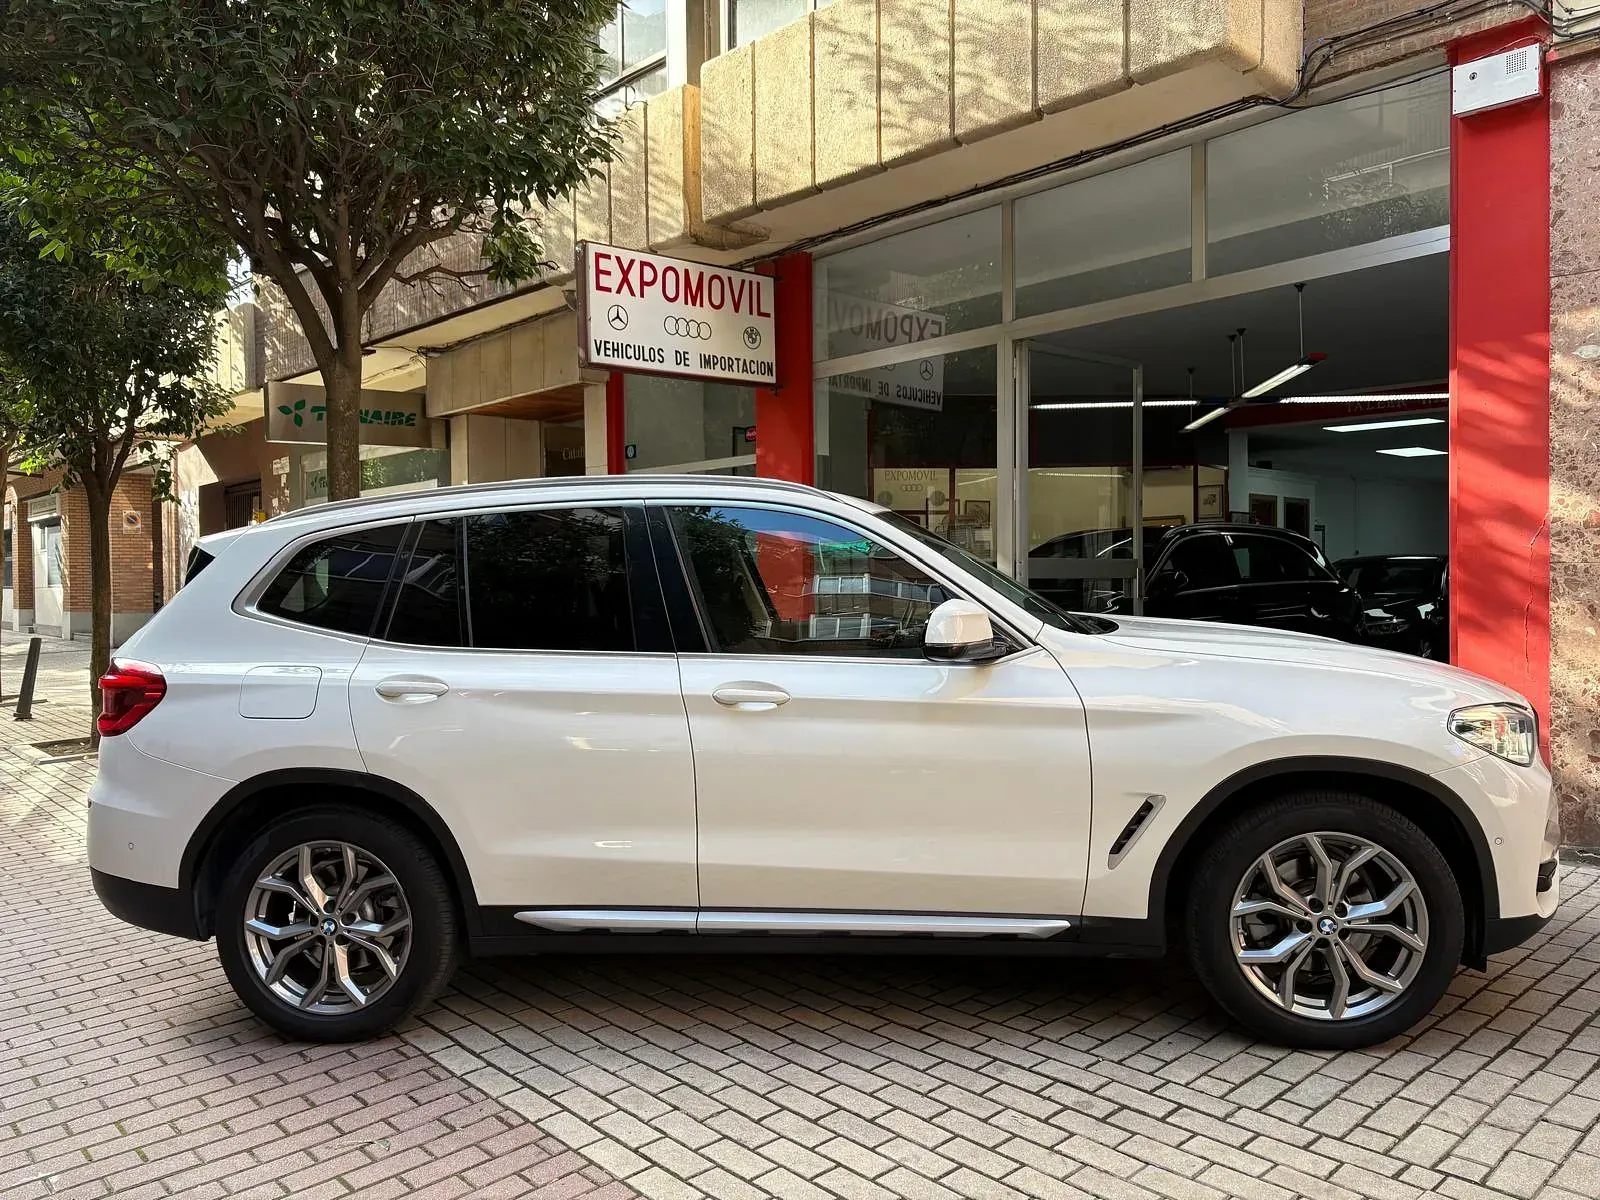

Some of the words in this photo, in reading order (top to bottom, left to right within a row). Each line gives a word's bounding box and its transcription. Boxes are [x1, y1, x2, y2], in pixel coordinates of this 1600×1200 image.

[594, 252, 771, 318] EXPOMOVIL
[594, 339, 665, 364] VEHICULOS
[675, 351, 690, 367] DE
[699, 353, 774, 377] IMPORTACION
[884, 470, 938, 481] EXPOMOVIL
